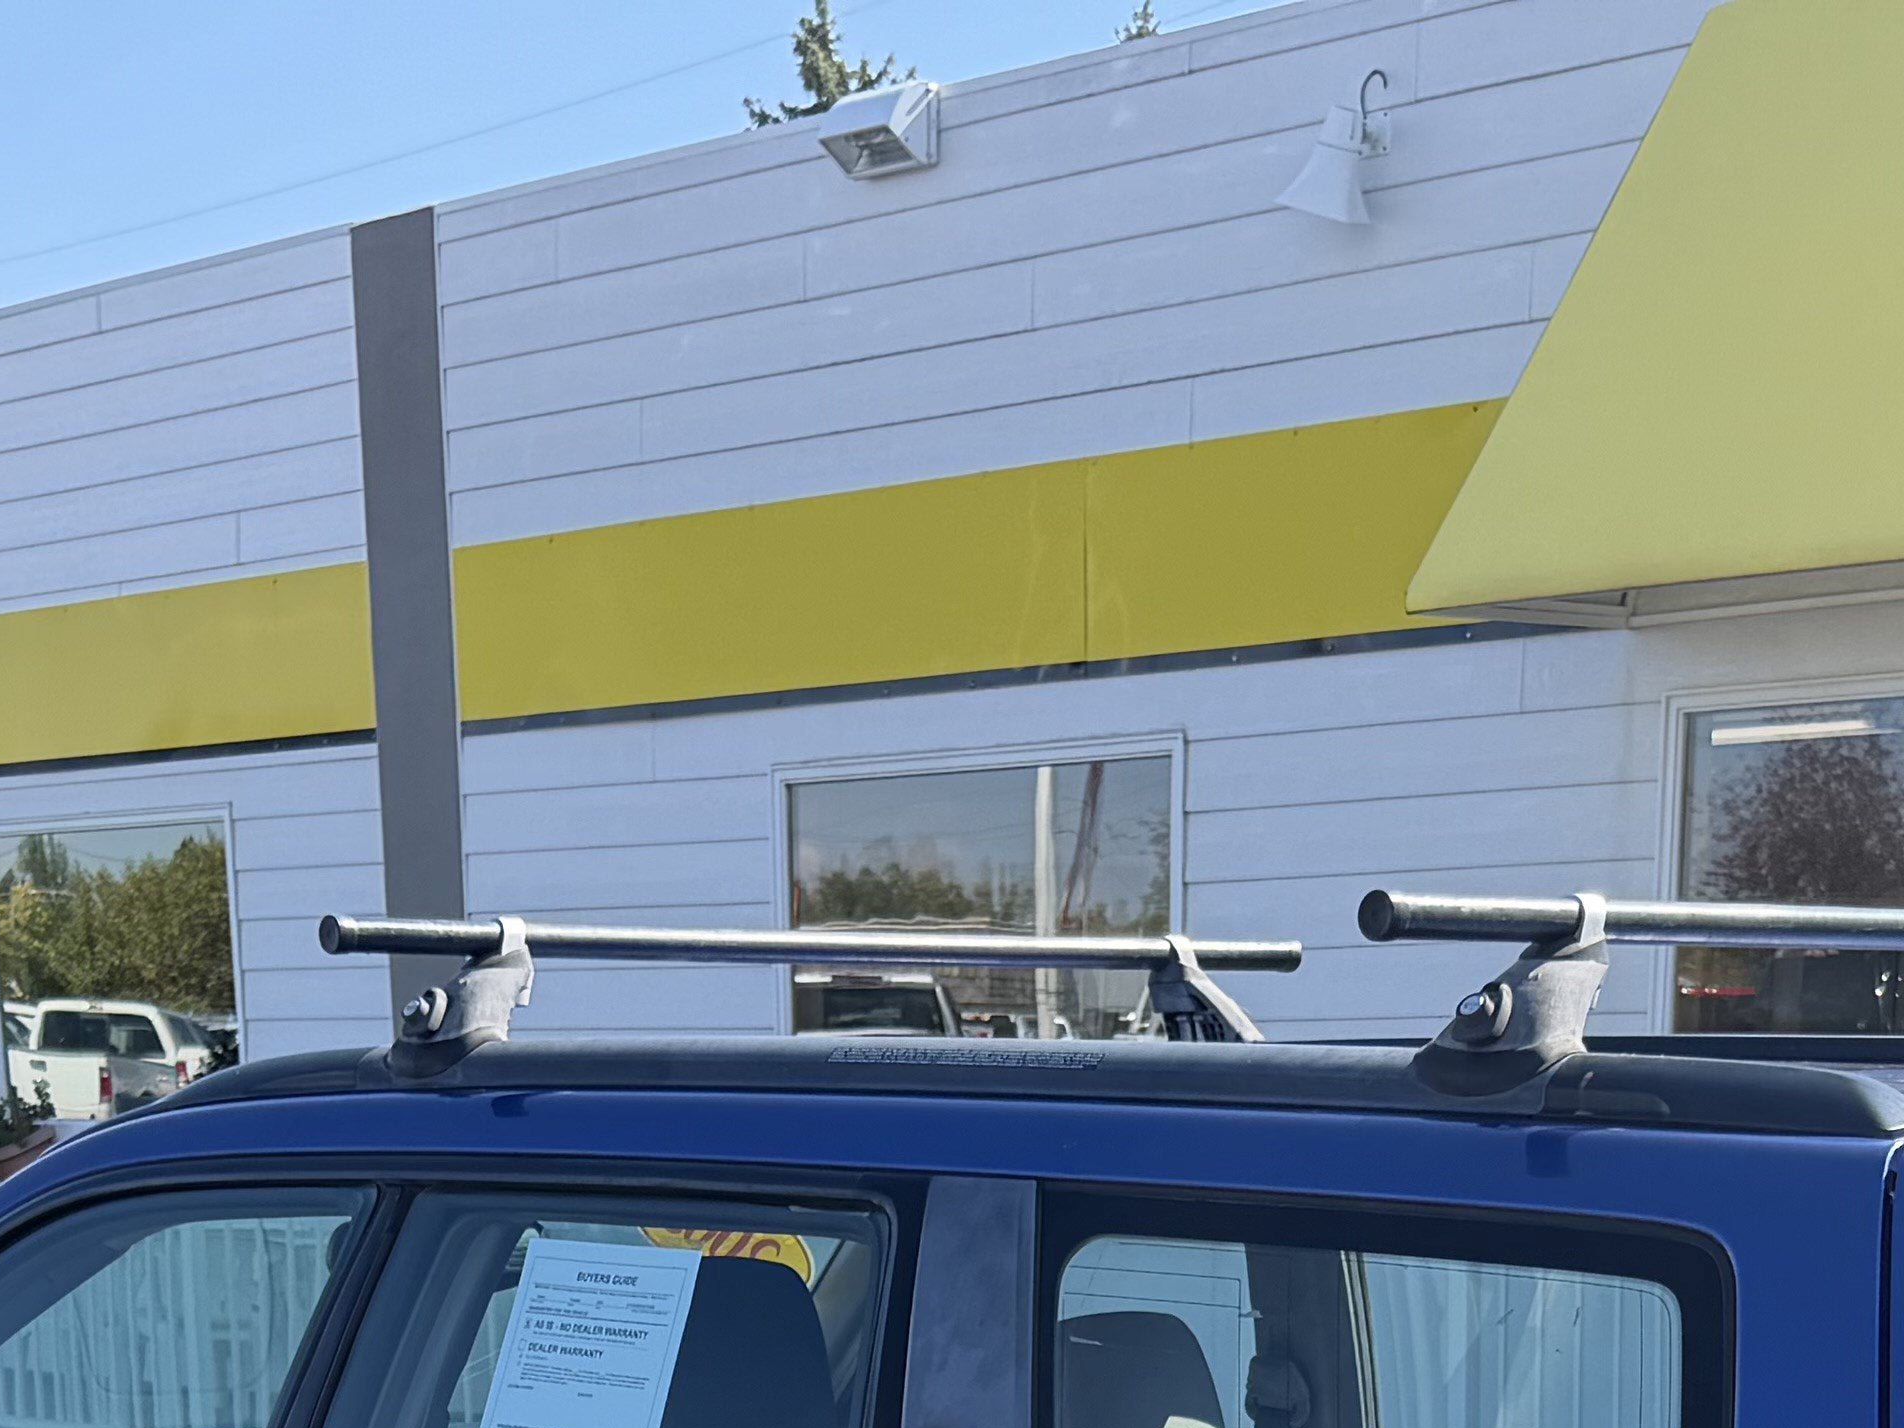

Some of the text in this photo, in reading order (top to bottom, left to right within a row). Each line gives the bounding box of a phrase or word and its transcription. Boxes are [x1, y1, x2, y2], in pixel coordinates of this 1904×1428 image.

[577, 1271, 639, 1287] BUYERS GUIDE
[573, 1323, 604, 1336] DEALER
[604, 1327, 649, 1341] WARRANTY
[528, 1342, 558, 1354] DEALER
[559, 1345, 604, 1360] WARRANTY
